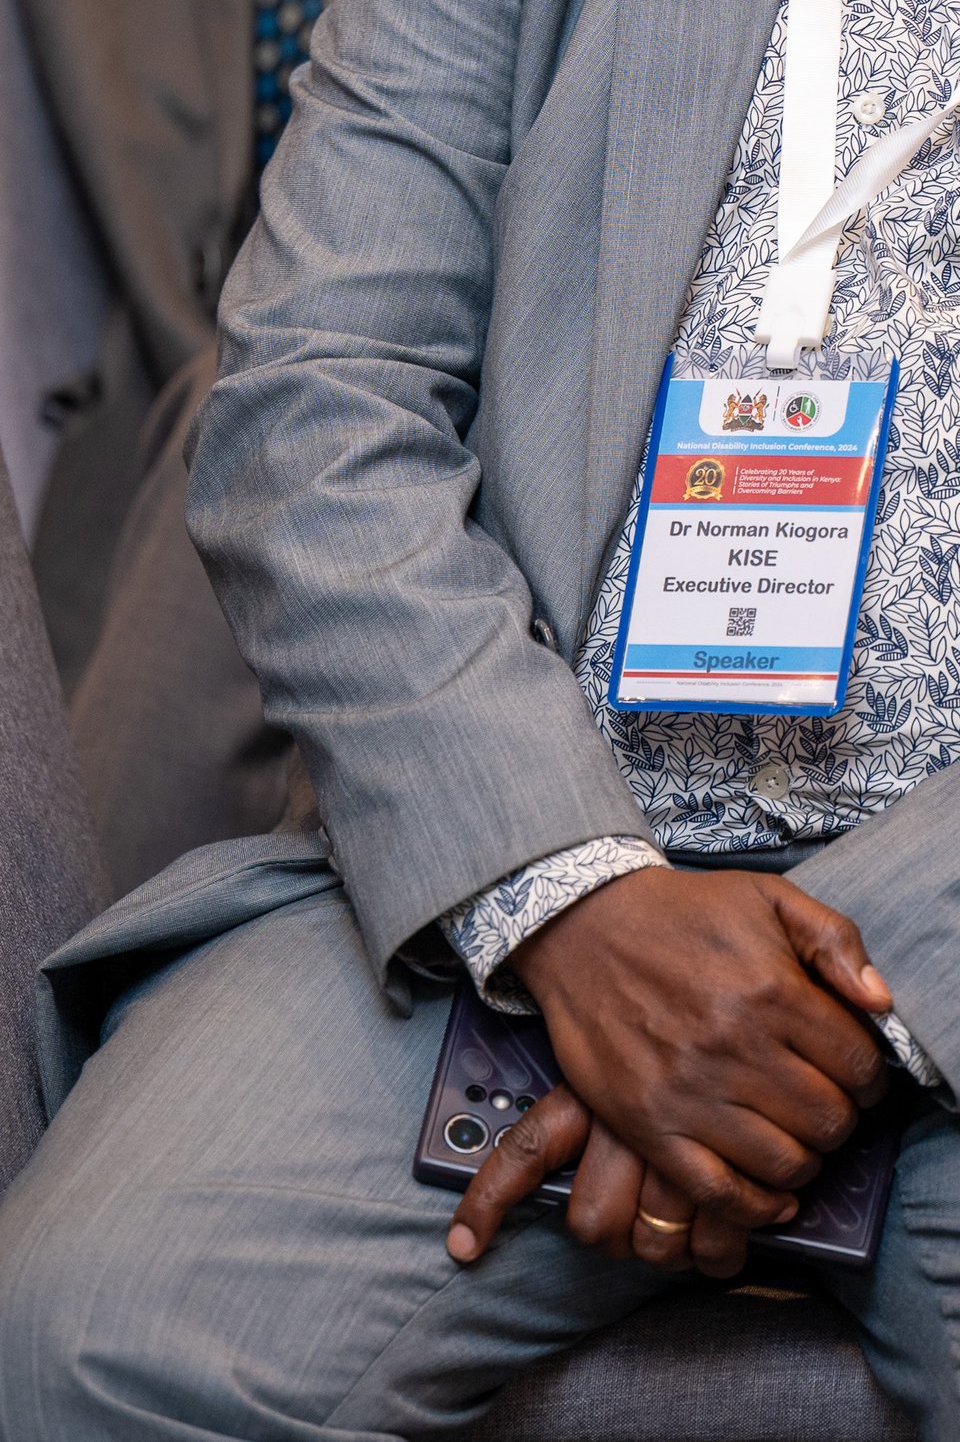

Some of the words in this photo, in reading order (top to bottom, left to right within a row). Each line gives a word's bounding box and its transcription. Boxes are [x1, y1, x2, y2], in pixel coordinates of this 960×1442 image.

[677, 442, 711, 450] National
[712, 442, 749, 452] Disability
[750, 442, 786, 451] Inclusion
[788, 443, 837, 452] Conference,
[838, 444, 858, 452] 2024
[694, 468, 717, 485] 20
[740, 468, 778, 476] Celebrating
[819, 476, 842, 484] Kenya:
[669, 521, 692, 537] Dr
[696, 521, 769, 538] Norman
[775, 522, 849, 542] Kiogora
[727, 549, 779, 567] KISE
[662, 577, 752, 593] Executive
[757, 578, 835, 595] Director
[693, 650, 780, 673] Speaker
